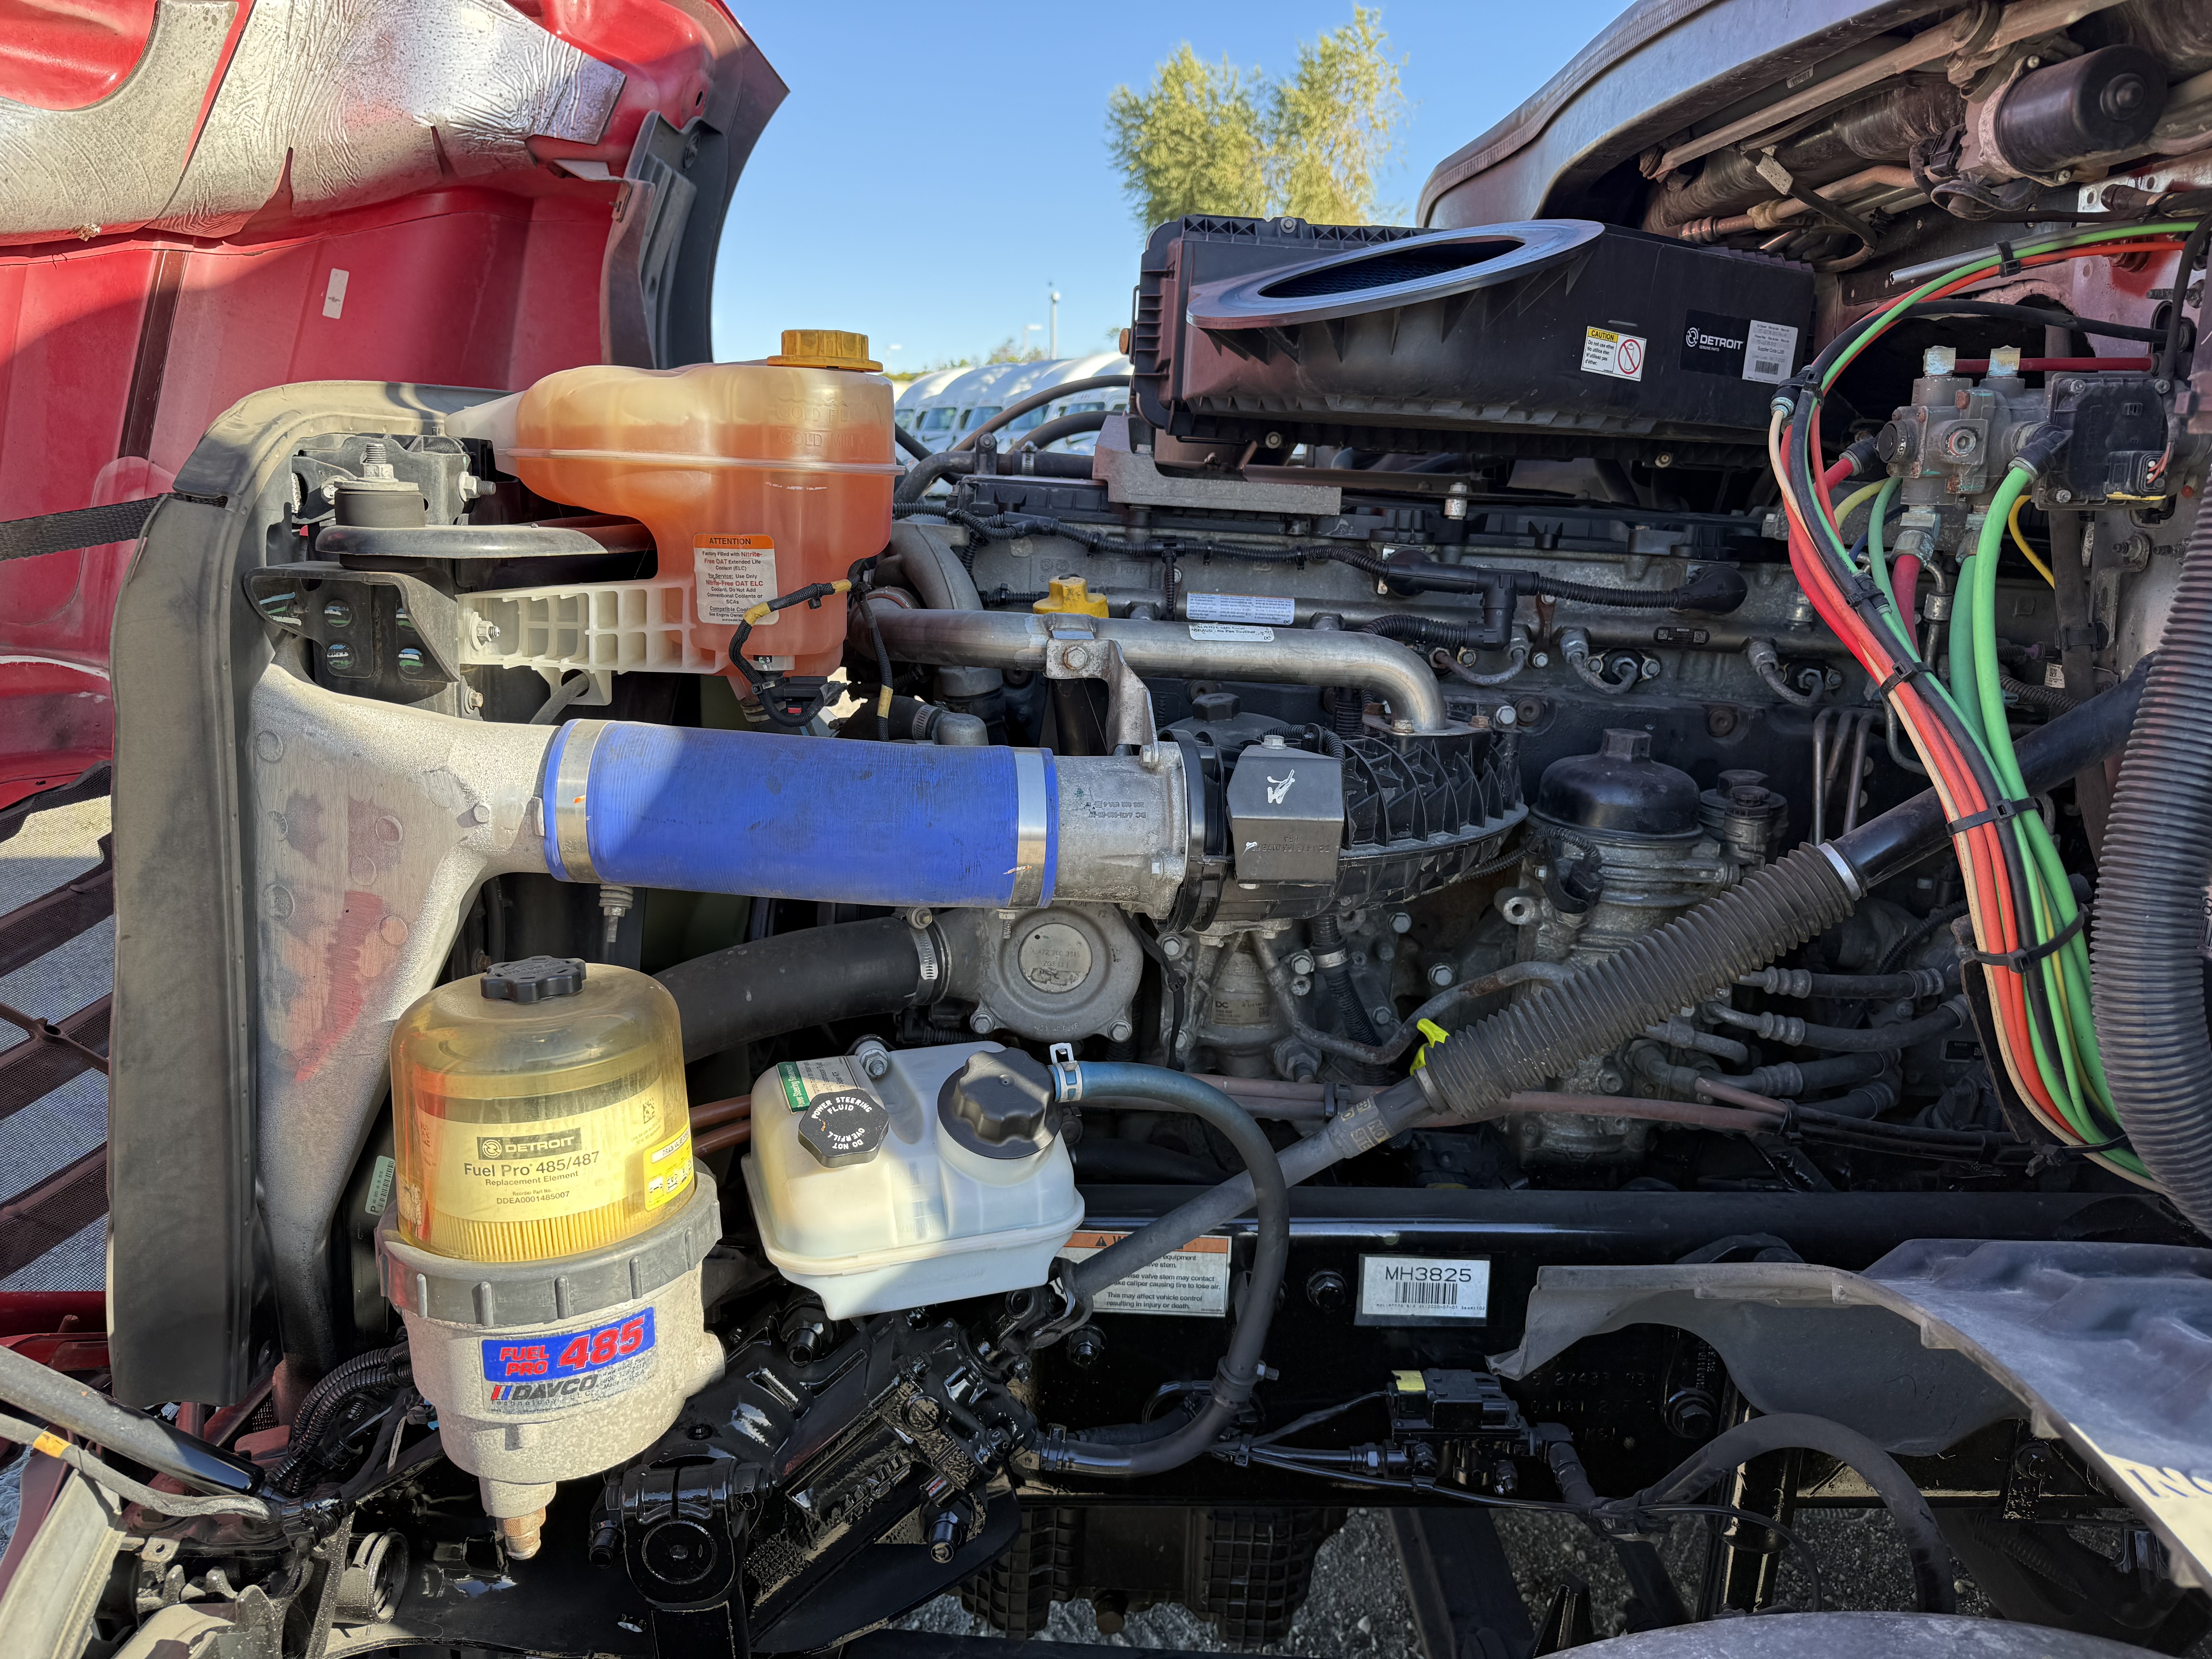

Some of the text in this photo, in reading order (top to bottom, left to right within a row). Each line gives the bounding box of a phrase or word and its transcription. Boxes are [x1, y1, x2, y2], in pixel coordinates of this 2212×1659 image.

[1591, 330, 1614, 341] CAUTION
[1700, 335, 1743, 350] DETROIT
[778, 405, 820, 421] COLD
[781, 431, 854, 447] COLD MIN
[785, 1065, 797, 1082] Reservoir
[791, 1080, 803, 1097] Steering
[811, 1099, 833, 1119] POWER
[827, 1104, 854, 1115] FLUID
[835, 1096, 872, 1113] STEERING
[827, 1128, 865, 1142] OVERFILL
[505, 1136, 574, 1153] DETROIT
[852, 1139, 864, 1148] DO
[464, 1151, 599, 1176] Fuel Pro 485/487
[486, 1170, 579, 1187] Replacement Element
[497, 1190, 570, 1204] DDEA0001485007
[1385, 1266, 1472, 1282] MH3825
[1126, 1281, 1148, 1289] caliper
[1143, 1301, 1161, 1309] injury
[557, 1315, 645, 1370] 485
[500, 1345, 550, 1361] FUEL
[505, 1360, 548, 1376] PRO
[603, 1356, 645, 1376] www.davco.com
[512, 1373, 599, 1401] DAVCO
[603, 1375, 616, 1383] 800
[603, 1380, 620, 1389] Made
